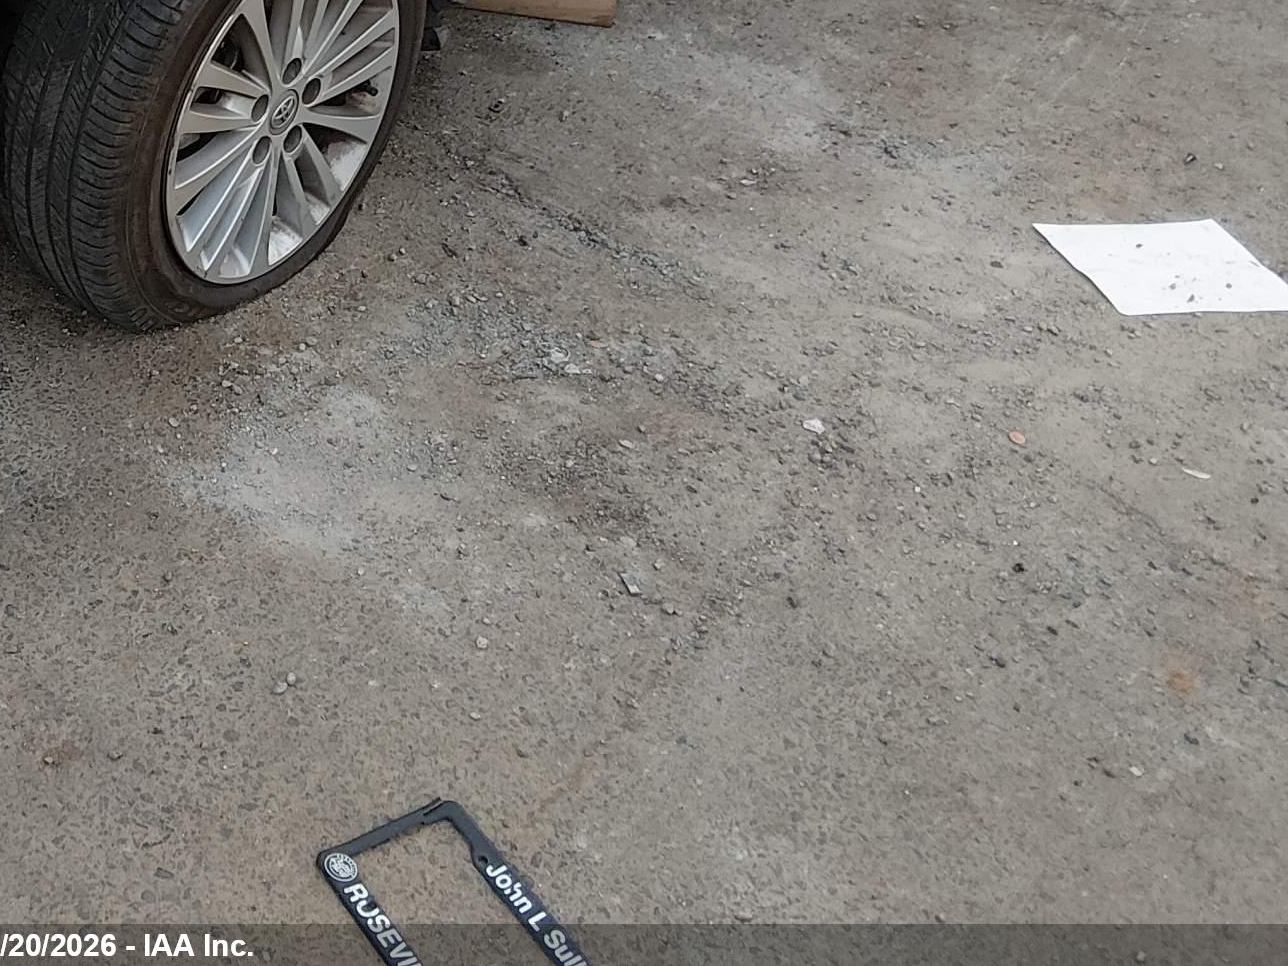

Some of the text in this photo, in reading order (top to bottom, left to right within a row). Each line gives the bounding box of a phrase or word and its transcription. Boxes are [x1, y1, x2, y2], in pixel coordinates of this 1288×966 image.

[486, 864, 588, 966] John L Sul
